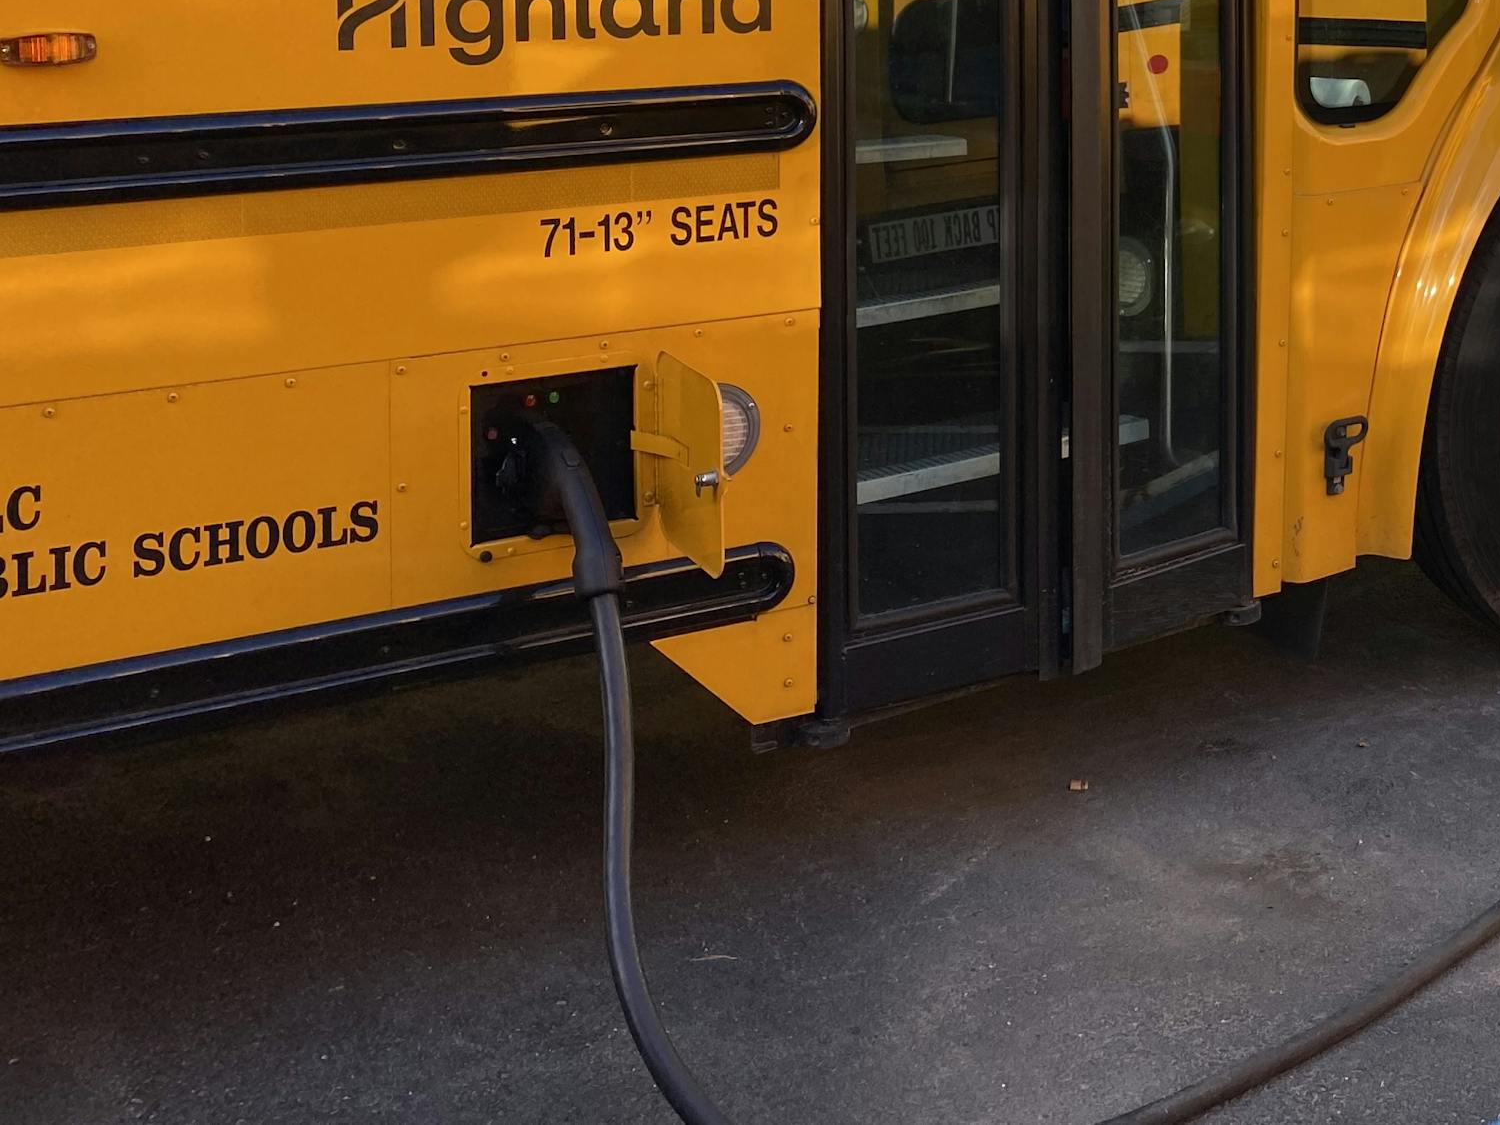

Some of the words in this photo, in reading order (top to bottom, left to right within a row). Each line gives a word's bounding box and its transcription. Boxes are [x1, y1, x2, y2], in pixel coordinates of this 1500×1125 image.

[670, 198, 779, 247] SEATS
[0, 540, 107, 600] LIC
[133, 500, 379, 578] SCHOOLS
